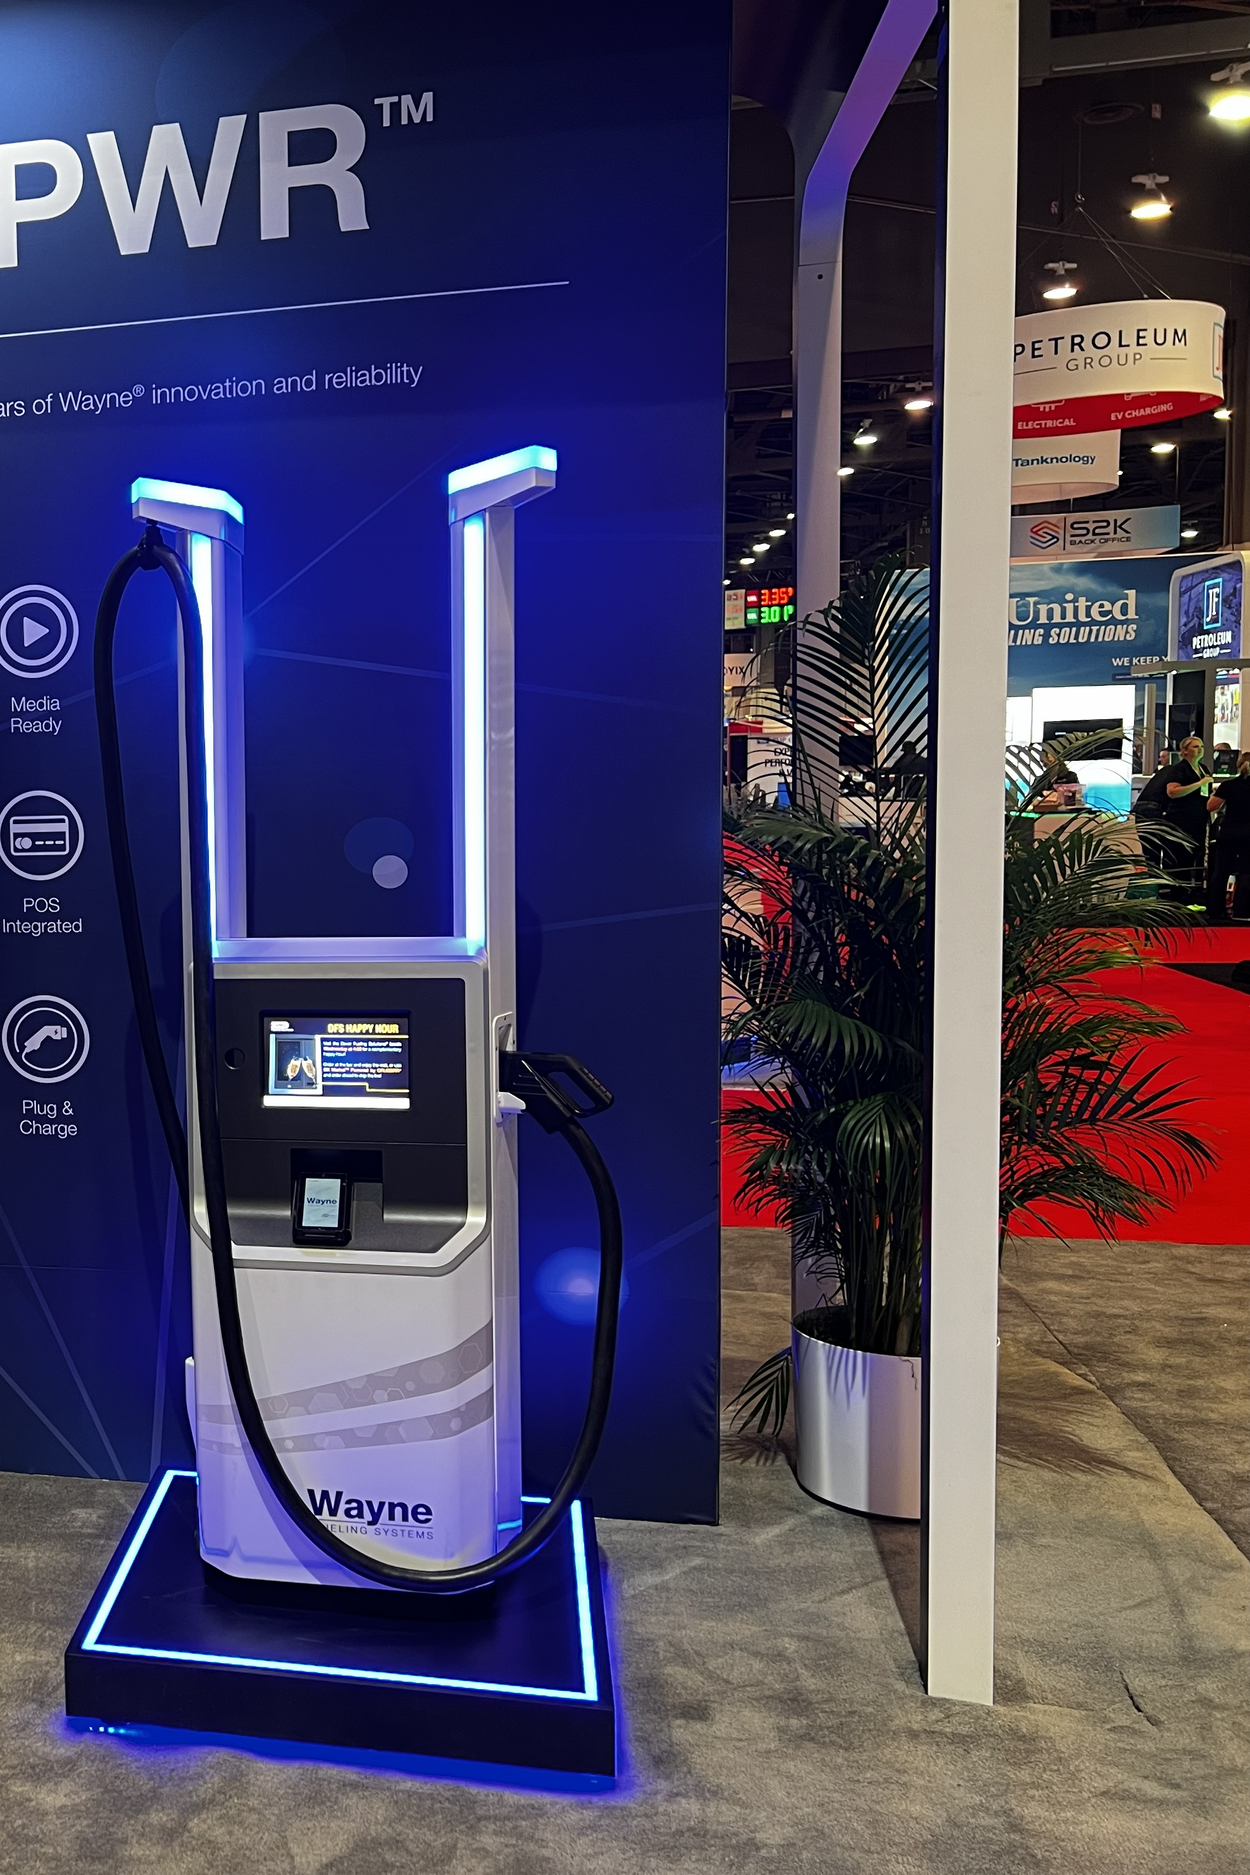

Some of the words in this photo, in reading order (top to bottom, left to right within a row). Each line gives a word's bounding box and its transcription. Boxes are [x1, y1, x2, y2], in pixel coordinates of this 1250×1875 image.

[1014, 328, 1187, 362] PETROLEUM
[1066, 353, 1143, 371] GROUP
[32, 393, 53, 414] of
[152, 376, 265, 403] innovation
[273, 370, 316, 394] and
[325, 363, 423, 389] reliability
[1111, 412, 1123, 420] EV
[1125, 403, 1173, 419] CHARGING
[1018, 418, 1076, 430] ELECTRICAL
[1013, 454, 1095, 467] Tanknology
[1070, 518, 1132, 537] S2K
[1099, 536, 1131, 544] OFFICE
[1009, 589, 1138, 625] United
[1008, 629, 1043, 646] LING
[1049, 624, 1136, 644] SOLUTIONS
[1192, 631, 1231, 649] PETROLEUM
[1112, 658, 1129, 666] WE
[11, 696, 60, 712] Media
[10, 717, 62, 735] Ready
[24, 898, 60, 913] POS
[3, 918, 82, 936] Integrated
[327, 1023, 344, 1033] DFS
[346, 1024, 374, 1033] HAPPY
[375, 1024, 399, 1033] HOUR
[23, 1100, 56, 1118] Plug
[62, 1101, 74, 1115] &
[20, 1120, 77, 1138] Charge
[307, 1489, 433, 1525] Wayne
[326, 1523, 367, 1535] ELING
[374, 1528, 433, 1540] SYSTEMS
